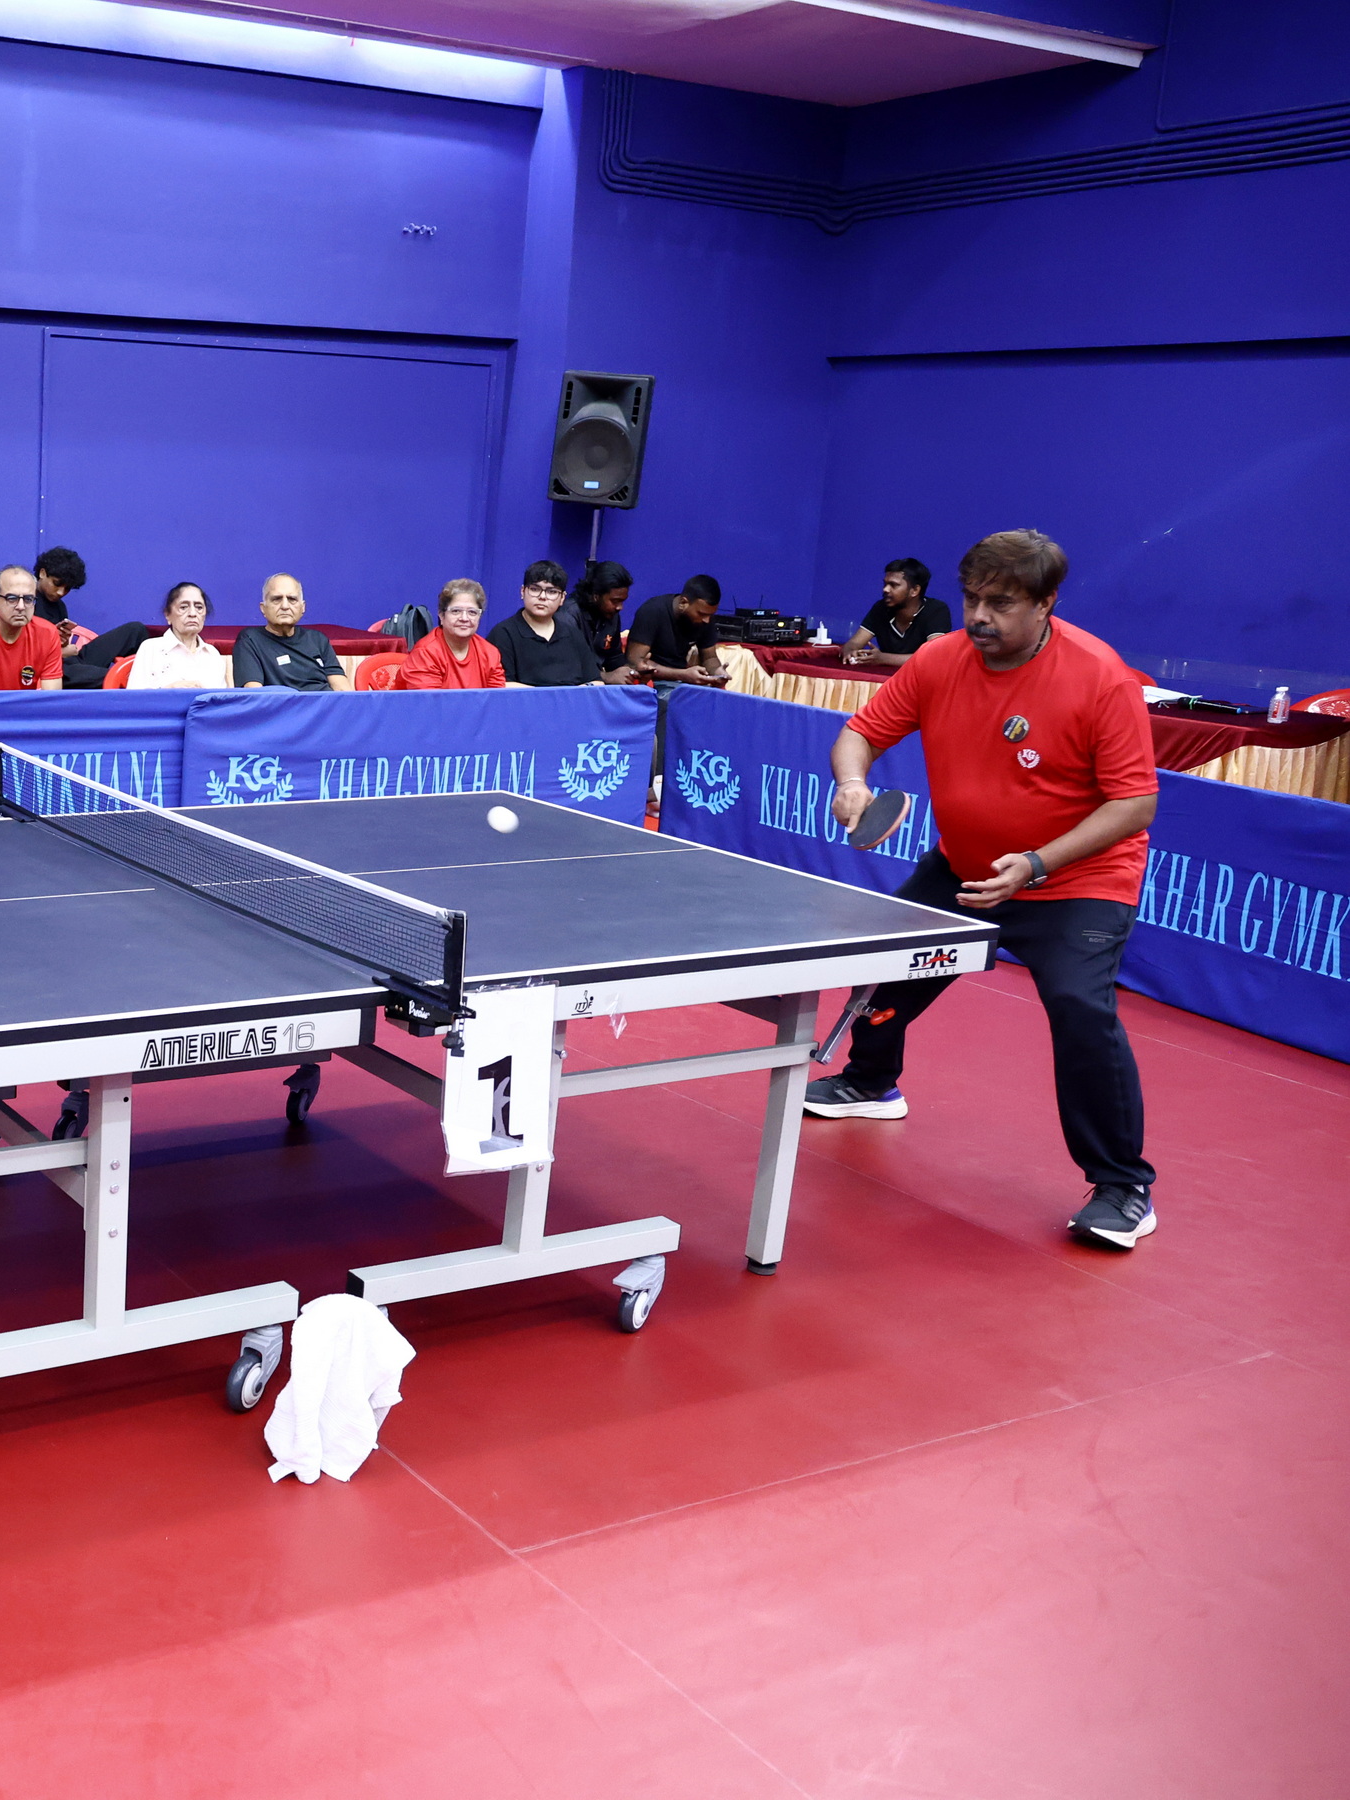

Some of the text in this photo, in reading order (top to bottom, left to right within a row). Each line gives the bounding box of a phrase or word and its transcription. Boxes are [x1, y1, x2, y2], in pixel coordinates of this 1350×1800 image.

[226, 754, 282, 792] KG
[319, 749, 536, 801] KHAR GYMKHANA
[574, 738, 622, 774] KG
[689, 748, 733, 785] KG
[759, 764, 820, 838] KHAR
[1136, 848, 1226, 945] KHAR
[907, 968, 955, 979] GLOBAL
[909, 948, 958, 969] STAG
[140, 1021, 316, 1069] AMERICAS 16
[478, 1055, 524, 1155] 1
